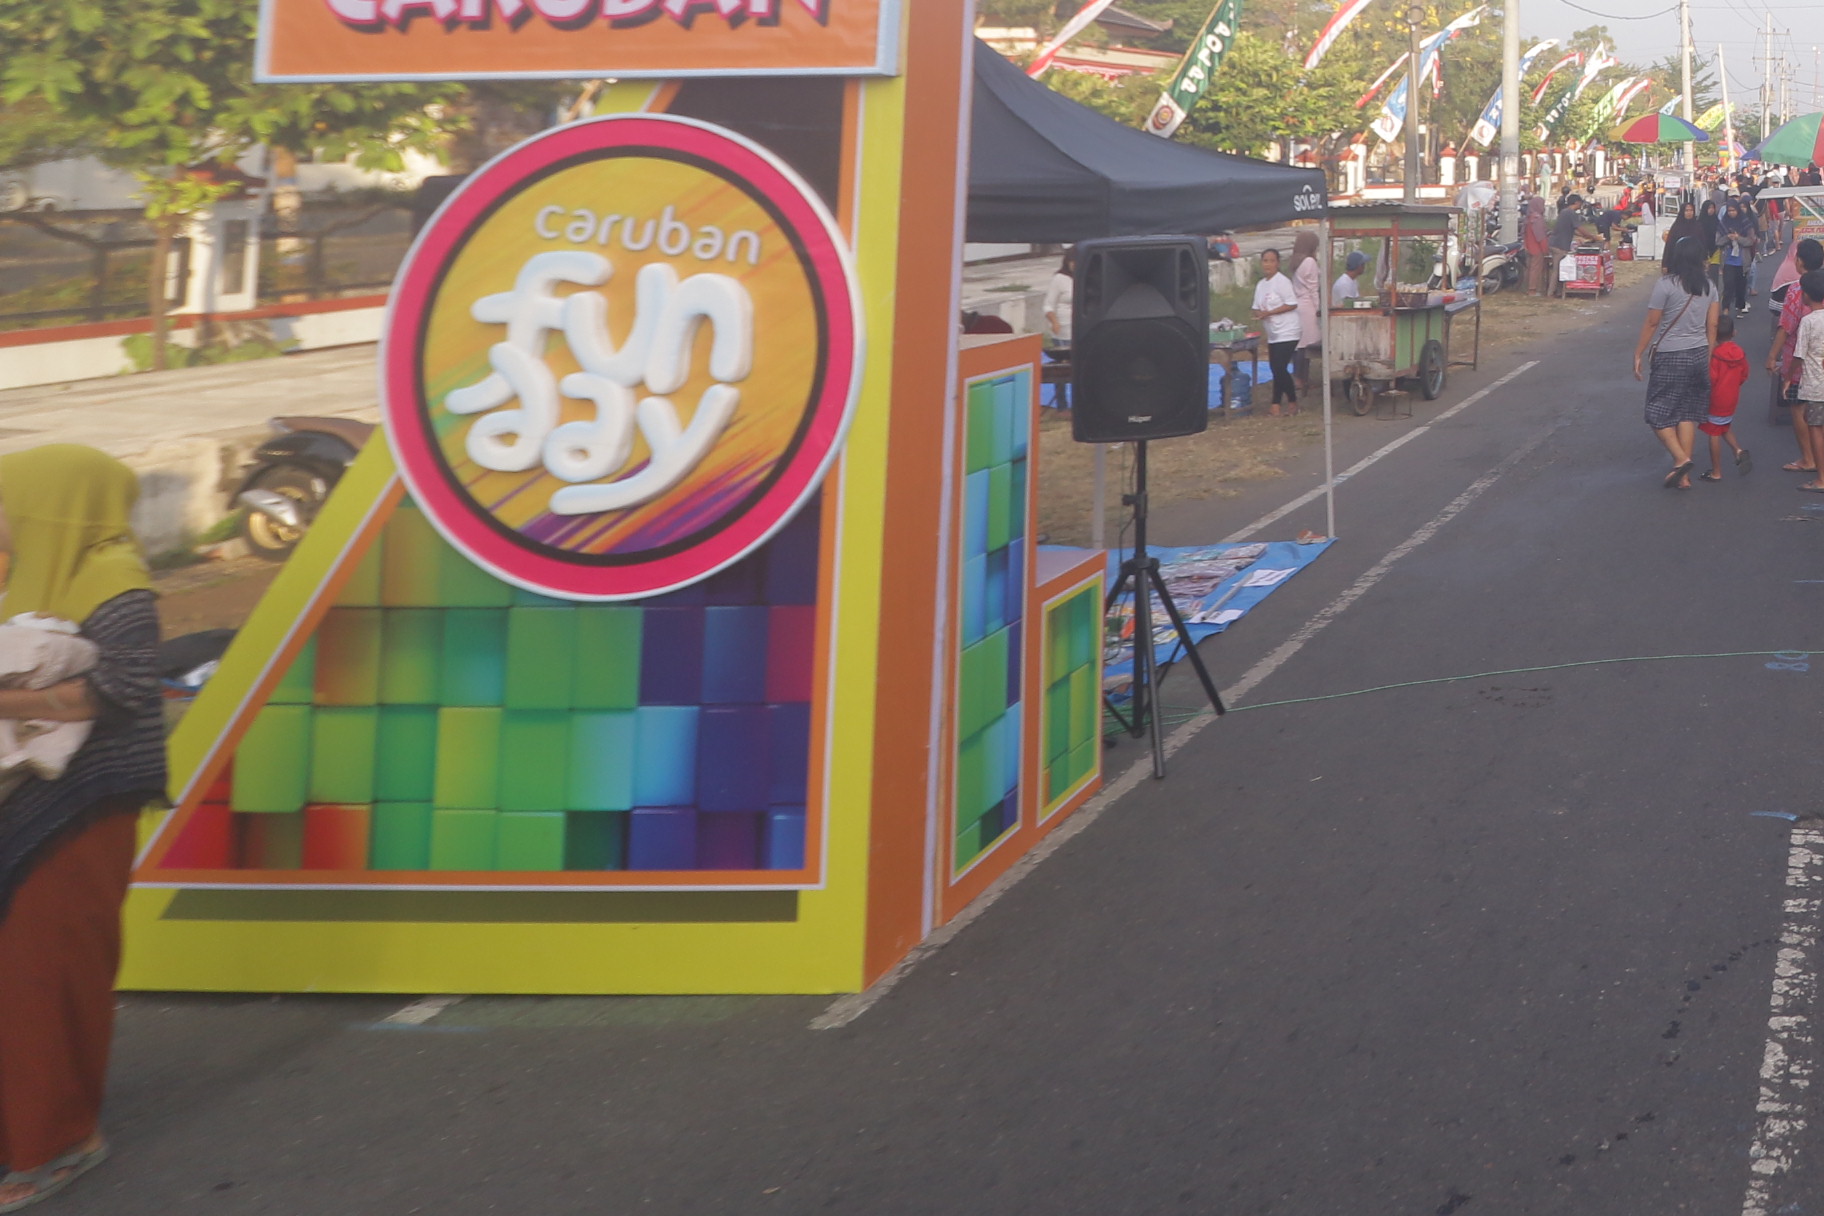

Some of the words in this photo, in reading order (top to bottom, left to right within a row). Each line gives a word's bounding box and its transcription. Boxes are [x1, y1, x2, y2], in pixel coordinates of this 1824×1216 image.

[535, 202, 760, 266] caruban
[472, 251, 755, 395] fun
[445, 341, 740, 516] day
